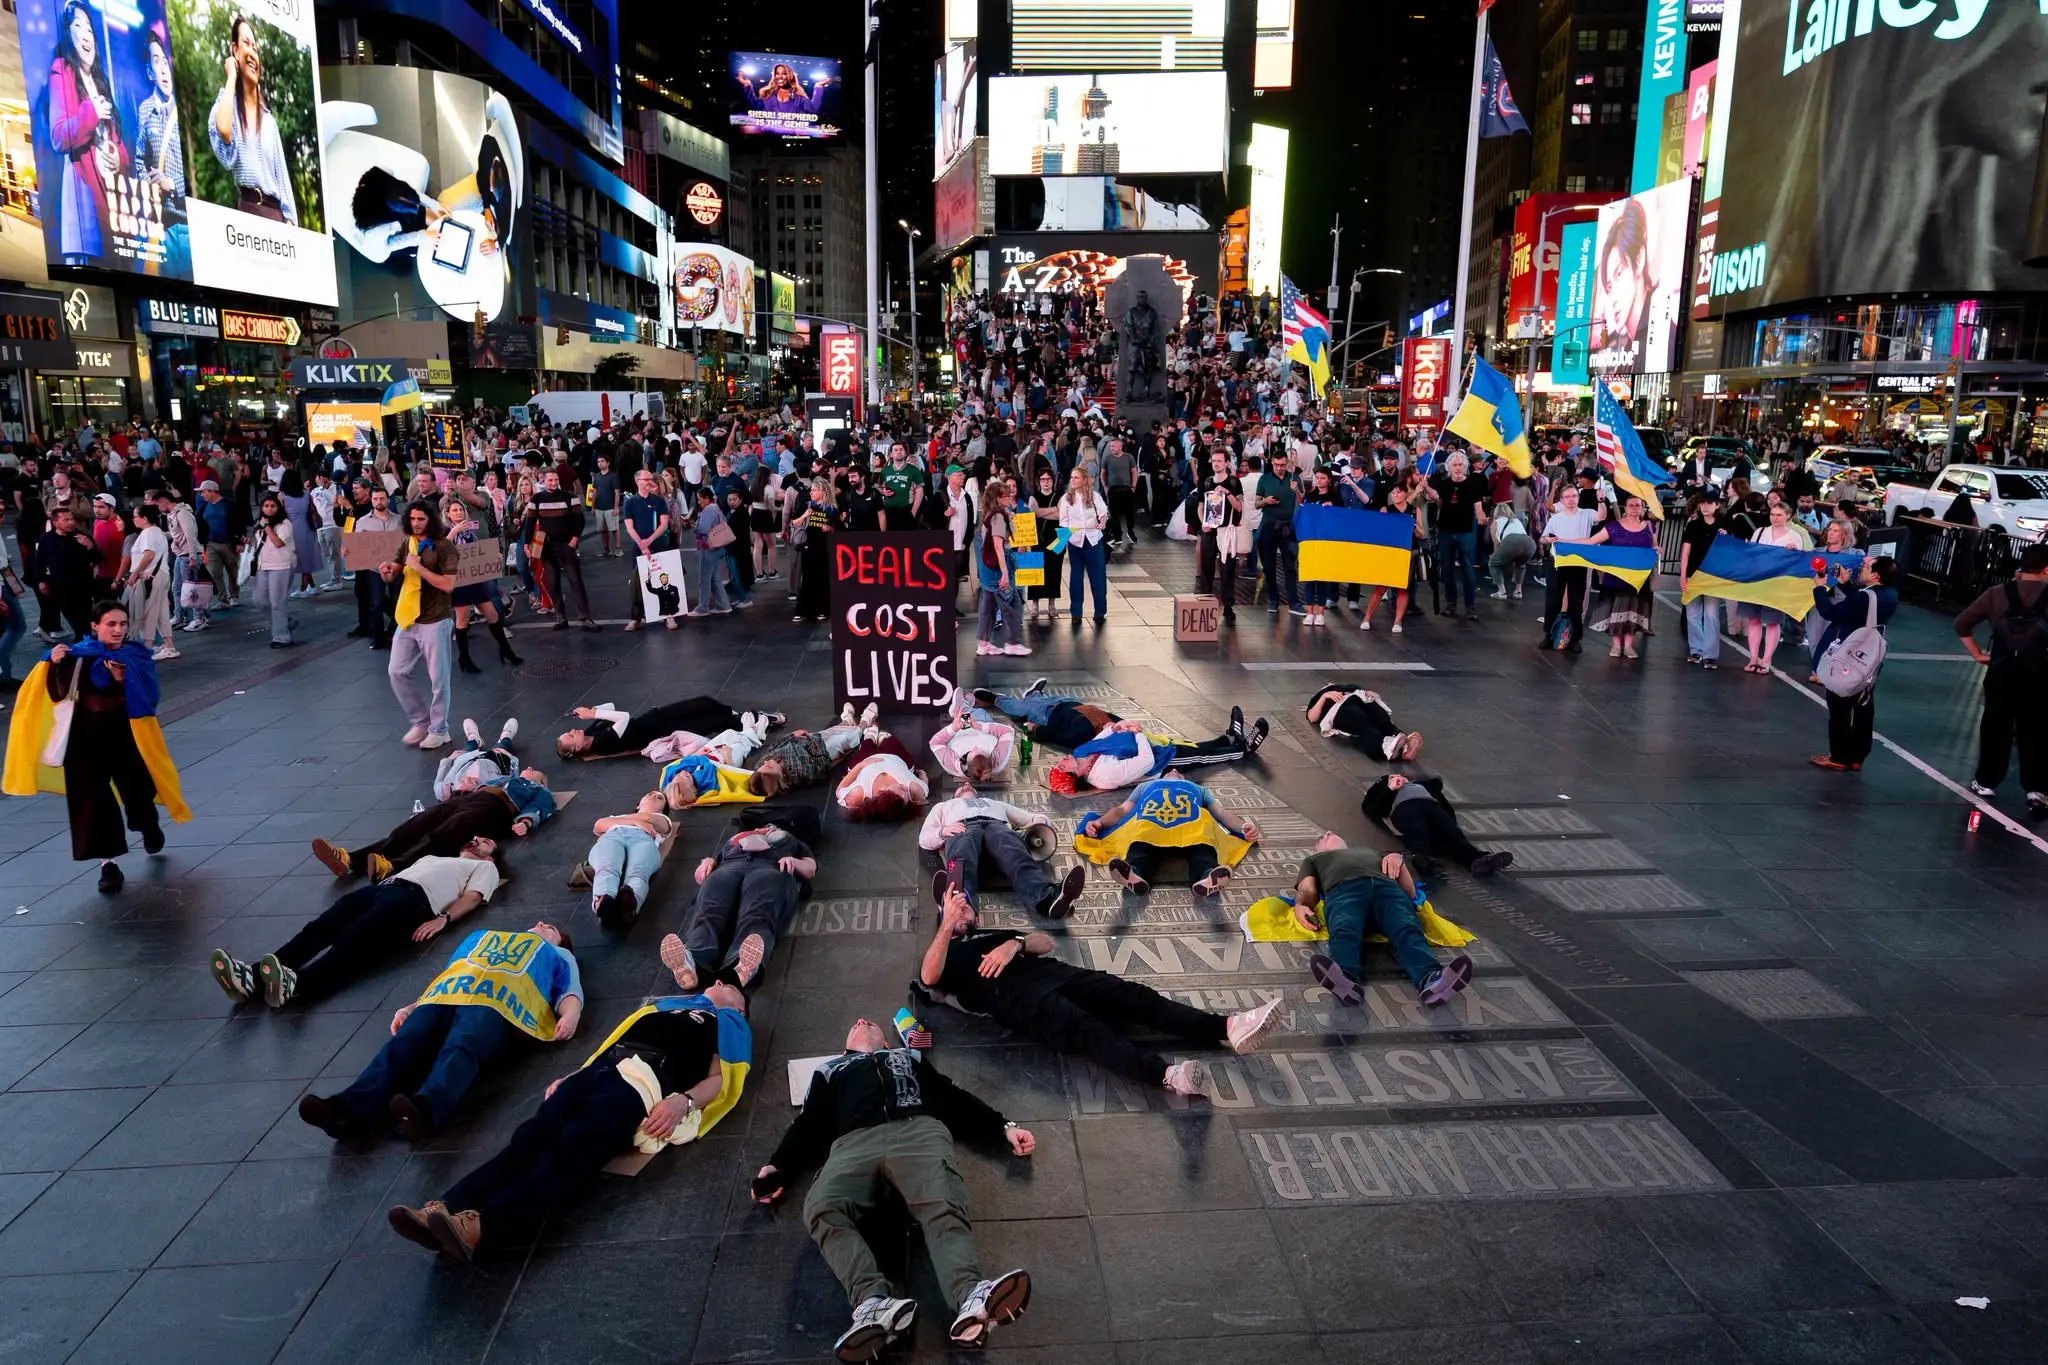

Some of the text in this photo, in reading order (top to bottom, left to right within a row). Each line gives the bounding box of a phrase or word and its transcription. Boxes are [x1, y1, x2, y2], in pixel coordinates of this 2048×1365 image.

[1691, 3, 1723, 14] BOOS
[747, 110, 818, 122] SHERRI SHEPHERD
[784, 121, 810, 129] GENIE
[226, 224, 296, 259] Genentech
[1582, 236, 1592, 253] day.
[1001, 246, 1036, 264] The
[1578, 253, 1589, 272] hair
[1697, 251, 1714, 285] 25
[1001, 266, 1060, 293] A-Z
[1566, 270, 1579, 319] Six benefits,
[150, 300, 218, 326] BLUE FIN
[6, 314, 57, 341] GIFTS
[225, 315, 288, 340] DOS CAMINOS
[305, 364, 394, 383] KLIKTIX
[407, 367, 451, 380] TICKET CENTER
[831, 337, 856, 391] tkts
[1412, 342, 1443, 400] tkts
[1877, 376, 1956, 387] CENTRAL PEK
[470, 561, 503, 577] BLOOD
[836, 543, 947, 591] DEALS
[846, 602, 942, 643] COST
[1182, 607, 1218, 633] DEALS
[845, 649, 954, 707] LIVES
[426, 975, 539, 1032] KRAINE
[1074, 1045, 1567, 1114] AMSTERDM
[1252, 1120, 1717, 1200] NEDERLANDER
